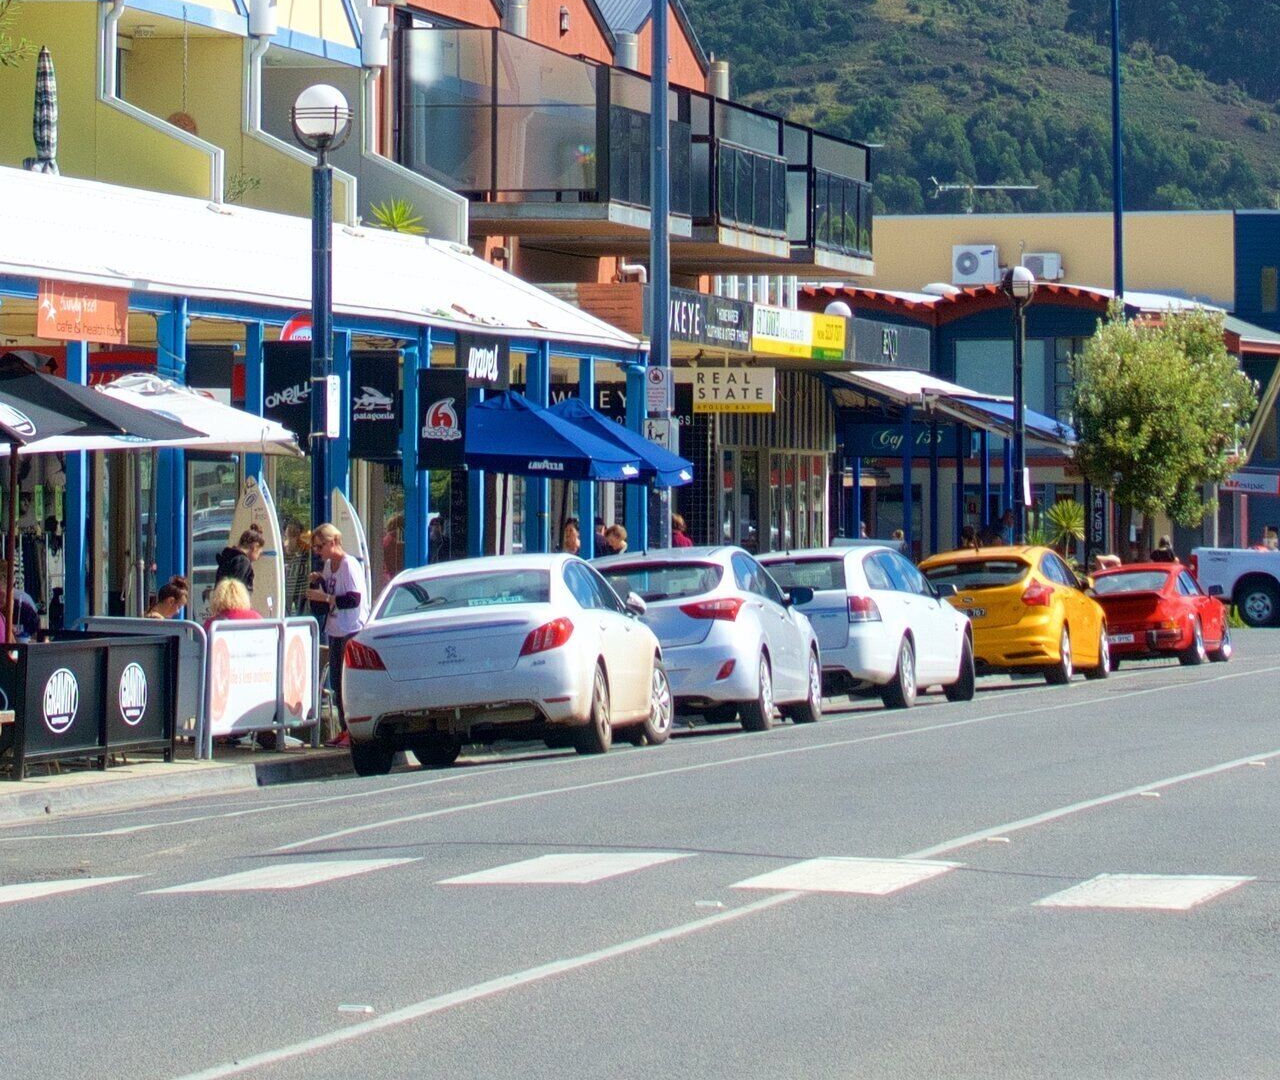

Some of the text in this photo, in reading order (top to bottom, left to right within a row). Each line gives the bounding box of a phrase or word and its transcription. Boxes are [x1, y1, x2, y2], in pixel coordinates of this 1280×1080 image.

[696, 372, 751, 385] REAL
[698, 387, 763, 400] STATE
[353, 412, 395, 422] patagonia
